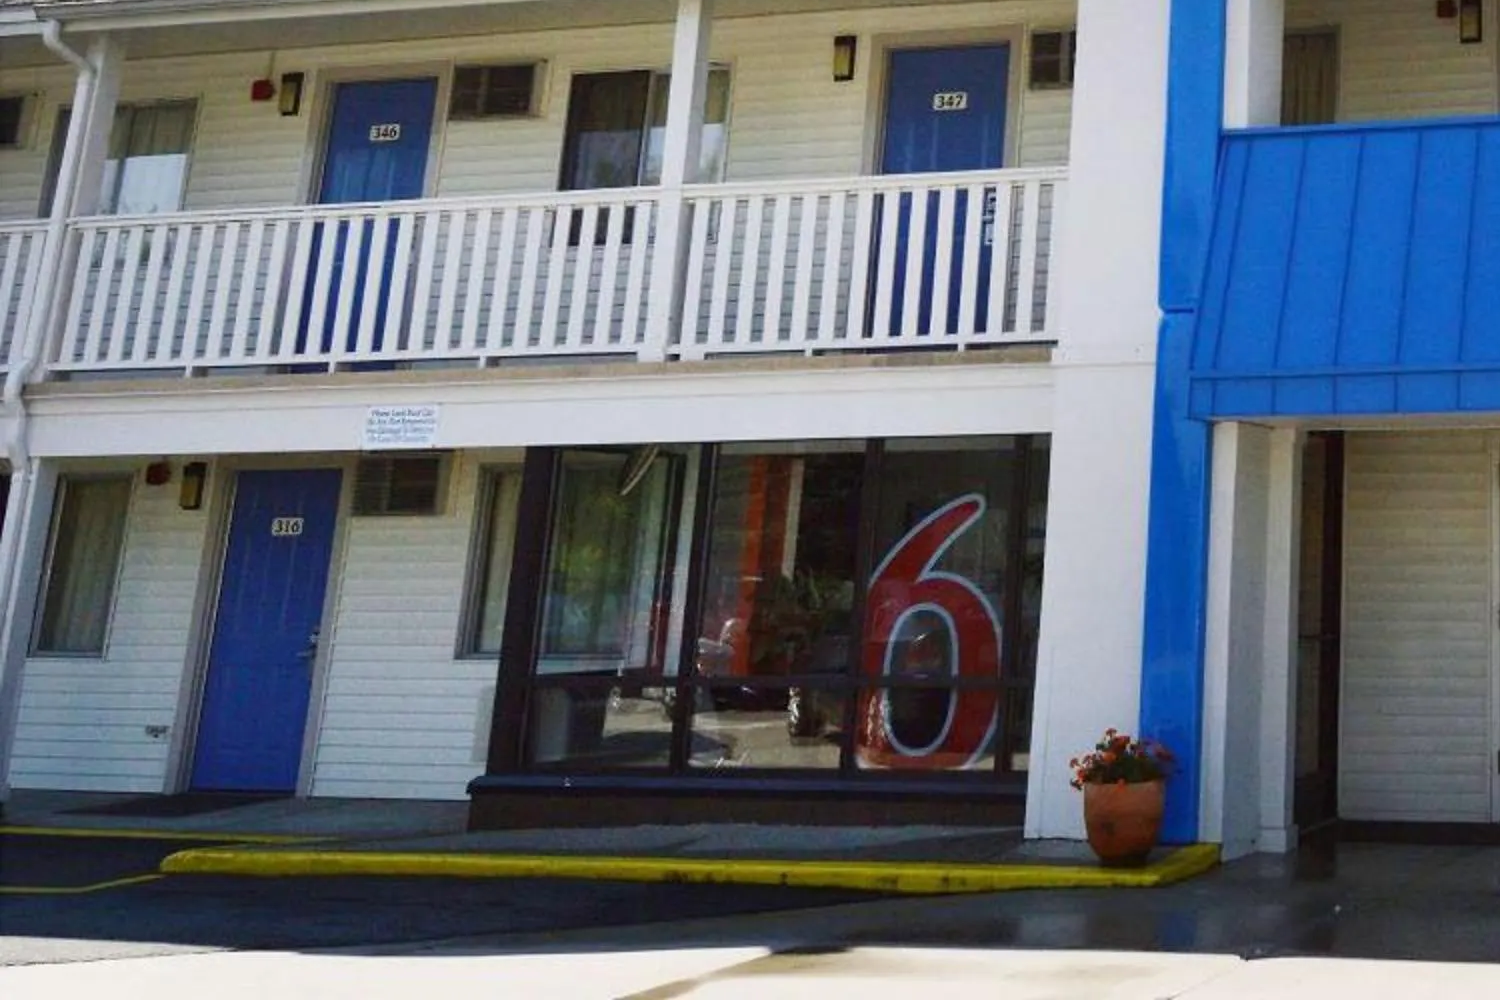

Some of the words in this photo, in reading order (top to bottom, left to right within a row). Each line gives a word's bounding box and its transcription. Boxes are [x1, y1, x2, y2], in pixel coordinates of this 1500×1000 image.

[935, 94, 965, 109] 347
[371, 125, 399, 139] 346
[272, 519, 301, 533] 316
[856, 493, 1002, 769] 6
